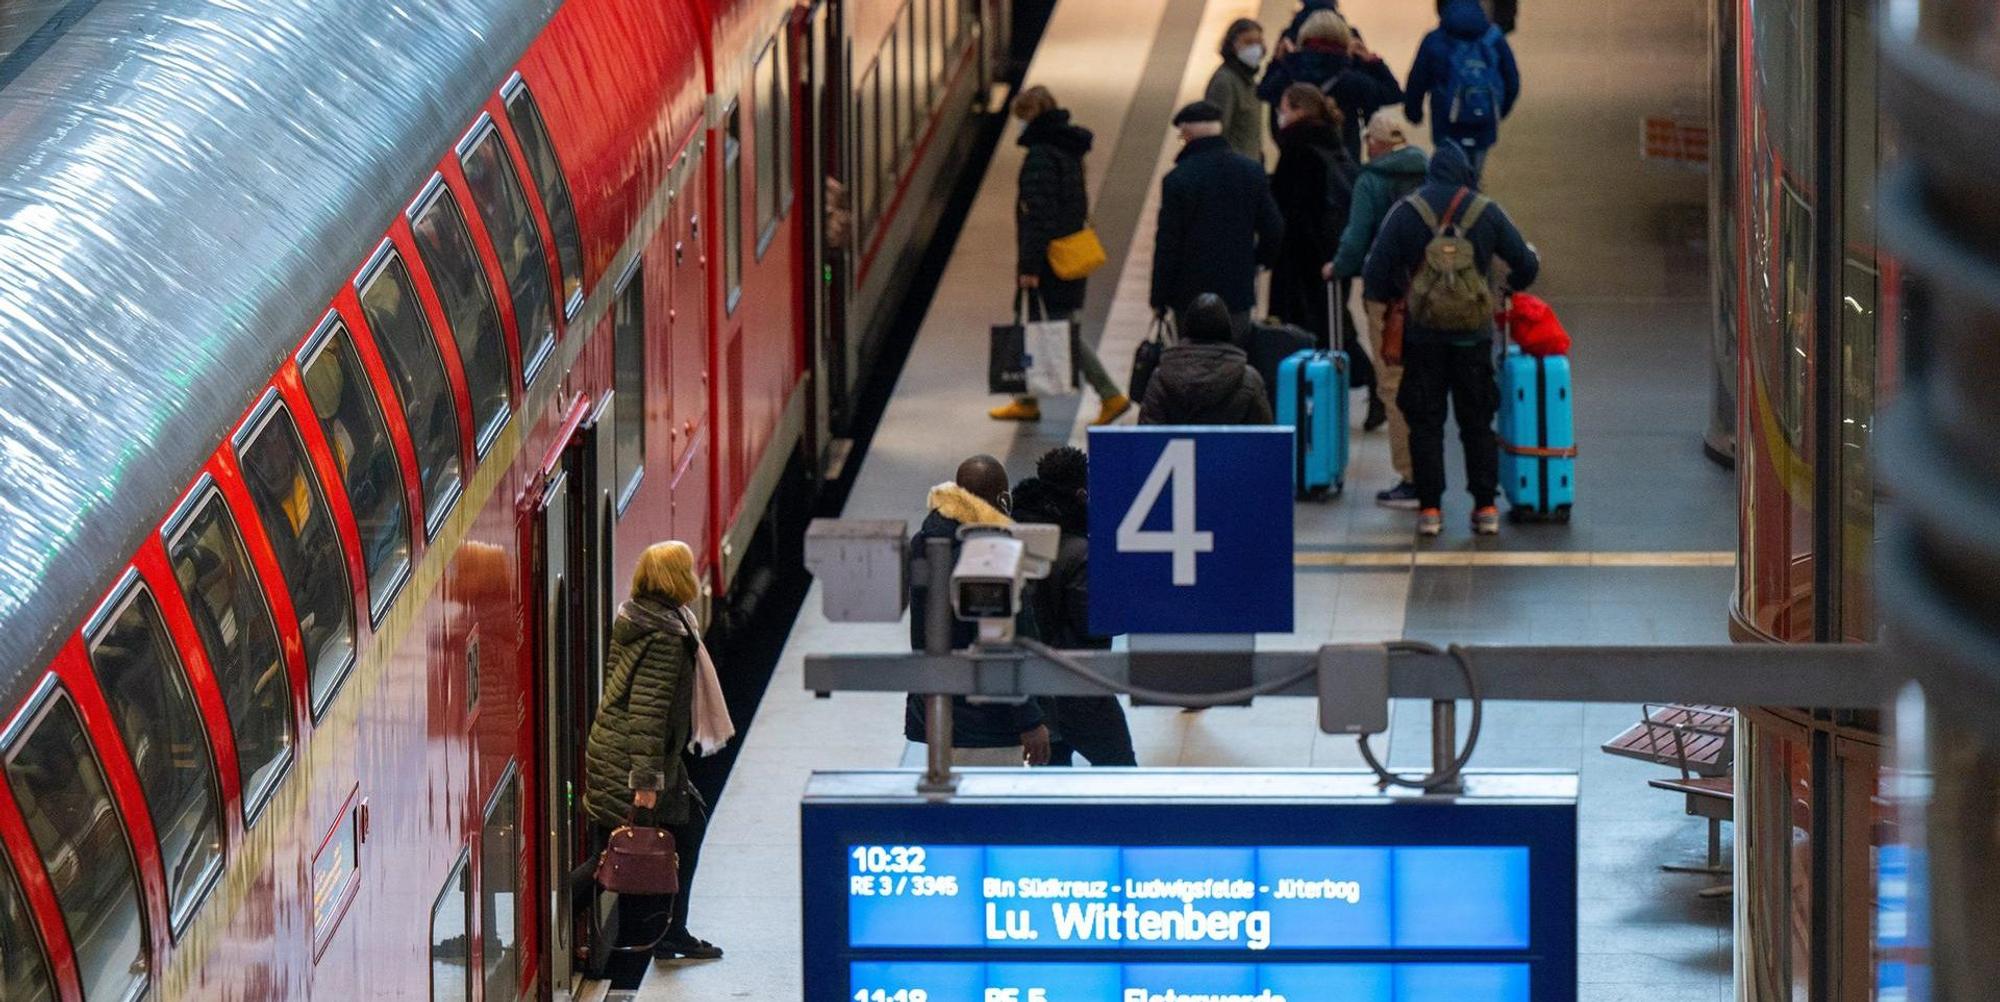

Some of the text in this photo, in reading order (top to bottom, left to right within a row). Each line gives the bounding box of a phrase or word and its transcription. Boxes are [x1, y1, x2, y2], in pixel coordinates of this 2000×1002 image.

[1116, 438, 1214, 586] 4
[853, 846, 926, 873] 10:32
[851, 875, 875, 896] RE
[879, 875, 893, 896] 3
[896, 876, 908, 895] /
[983, 877, 1016, 898] Bln
[1018, 877, 1108, 899] Südkreuz
[1110, 885, 1122, 893] -
[1125, 878, 1255, 903] Ludwigsfelde
[1273, 878, 1360, 904] Jüterbog
[986, 901, 1271, 950] Lu. Wittenberg
